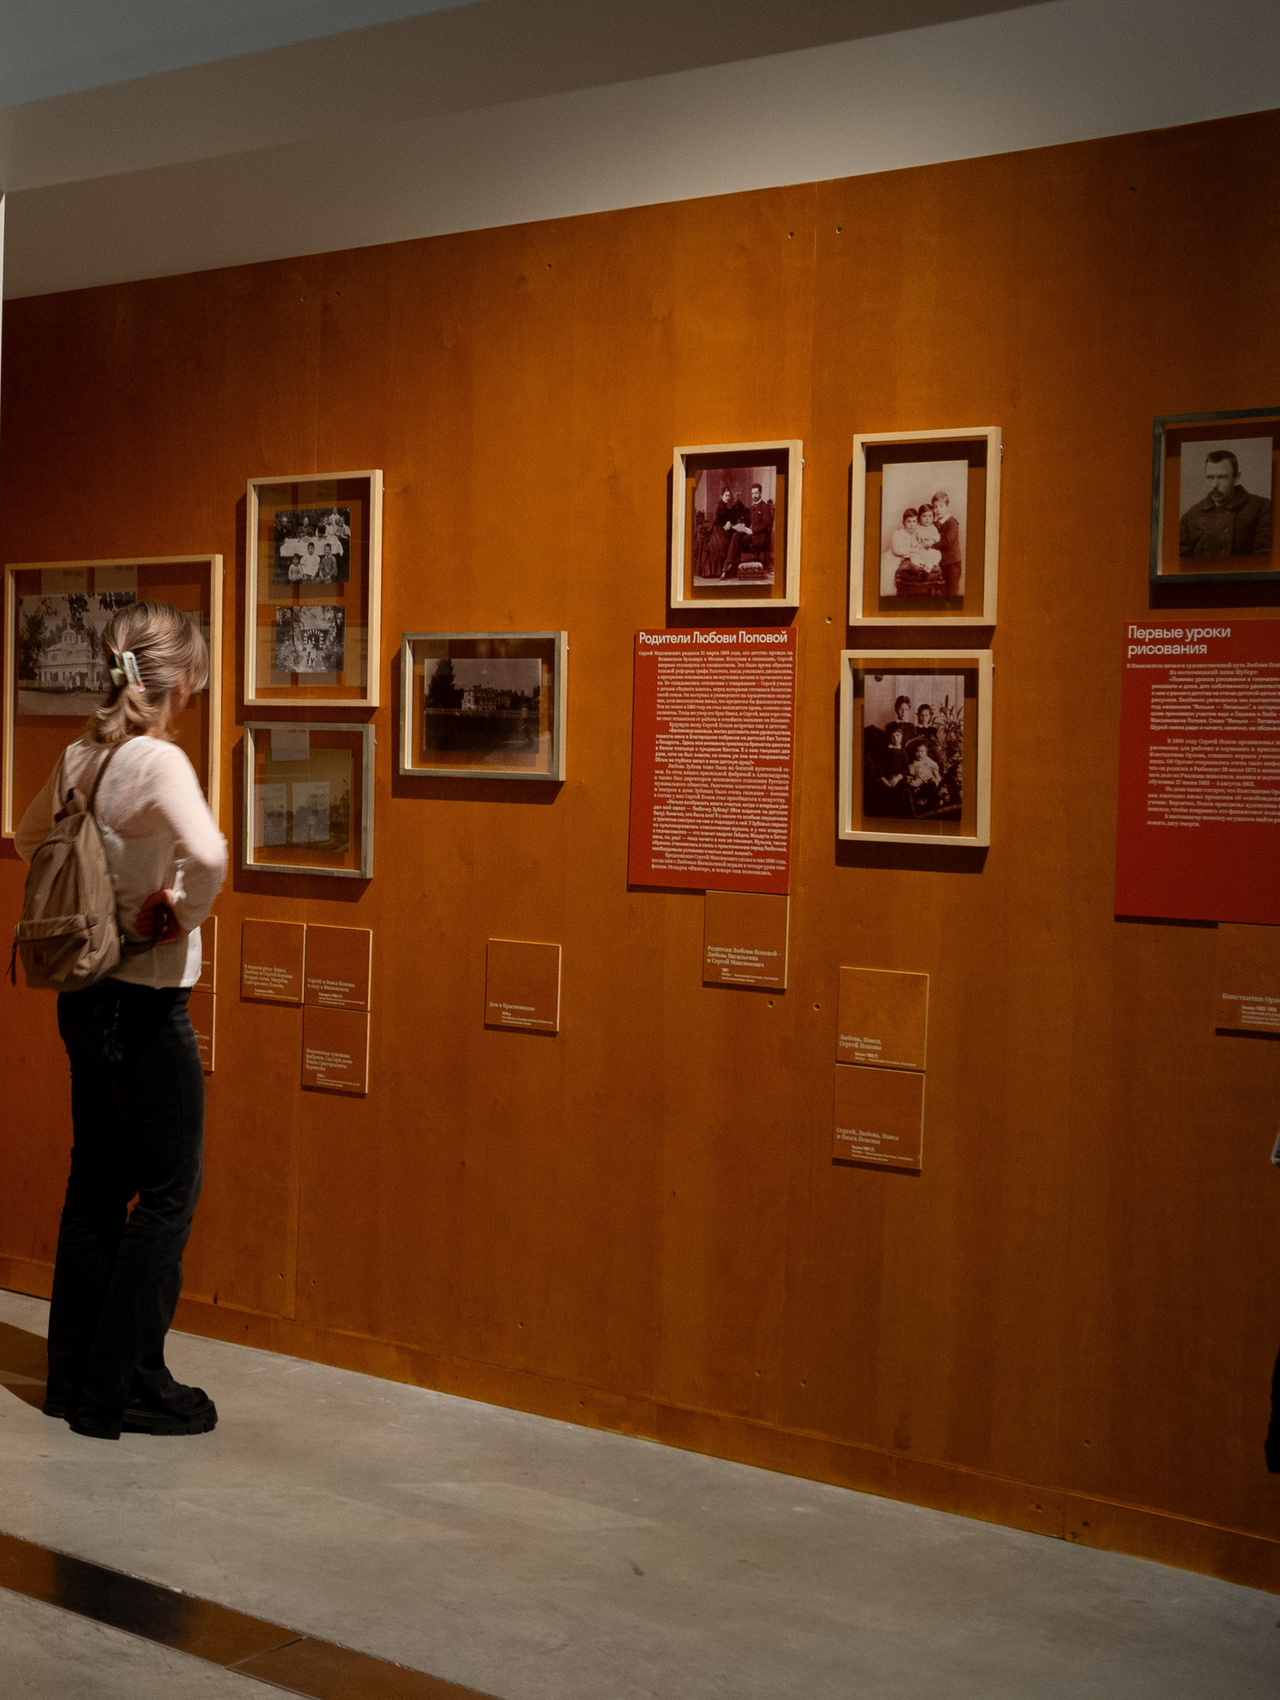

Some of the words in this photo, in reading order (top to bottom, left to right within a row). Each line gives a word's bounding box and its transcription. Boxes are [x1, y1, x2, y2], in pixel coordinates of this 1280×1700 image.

[639, 632, 691, 645] Родители
[692, 631, 737, 644] Любови
[739, 631, 788, 643] Поповой
[1128, 625, 1183, 642] Первые
[1185, 627, 1231, 642] уроки
[1128, 644, 1207, 658] рисования
